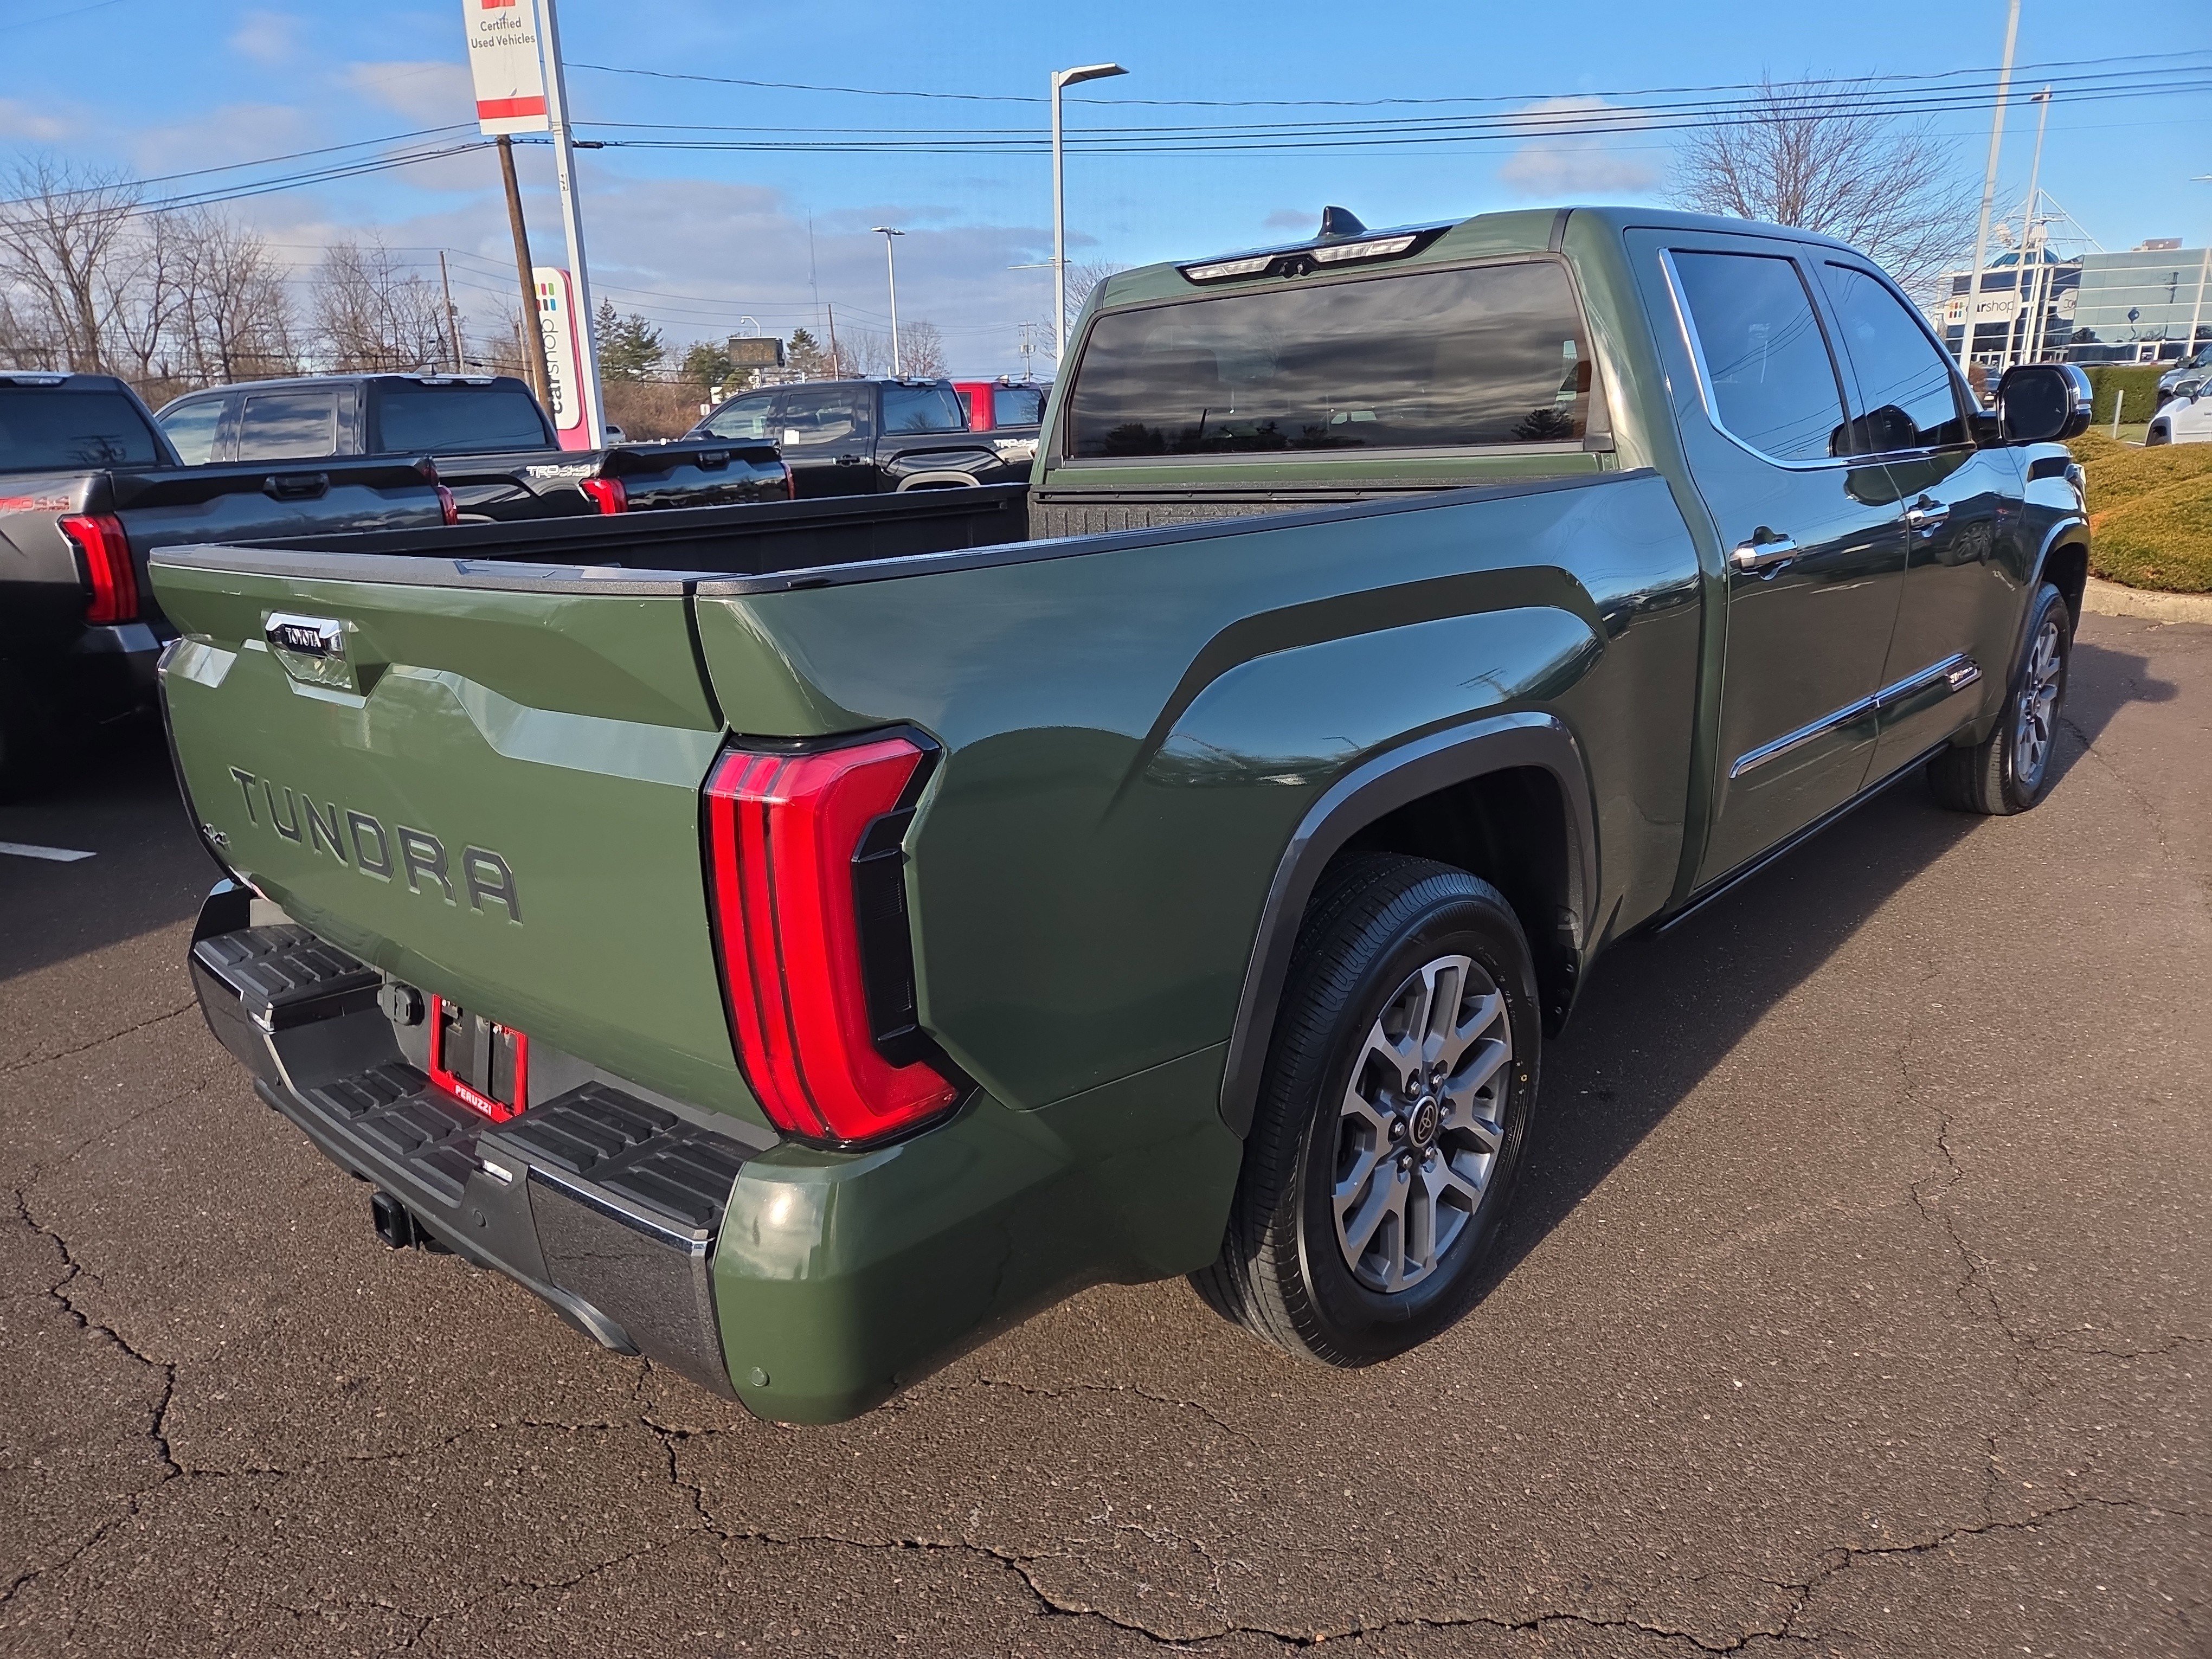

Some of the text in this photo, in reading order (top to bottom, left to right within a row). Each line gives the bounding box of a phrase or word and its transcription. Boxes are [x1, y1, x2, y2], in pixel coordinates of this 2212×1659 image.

[480, 16, 522, 31] Certified
[471, 33, 535, 49] Used Vehicles
[525, 465, 560, 479] TRD
[285, 627, 321, 648] TOYOTA
[228, 764, 524, 928] TUNDRA
[455, 1084, 492, 1116] PERUZZI
